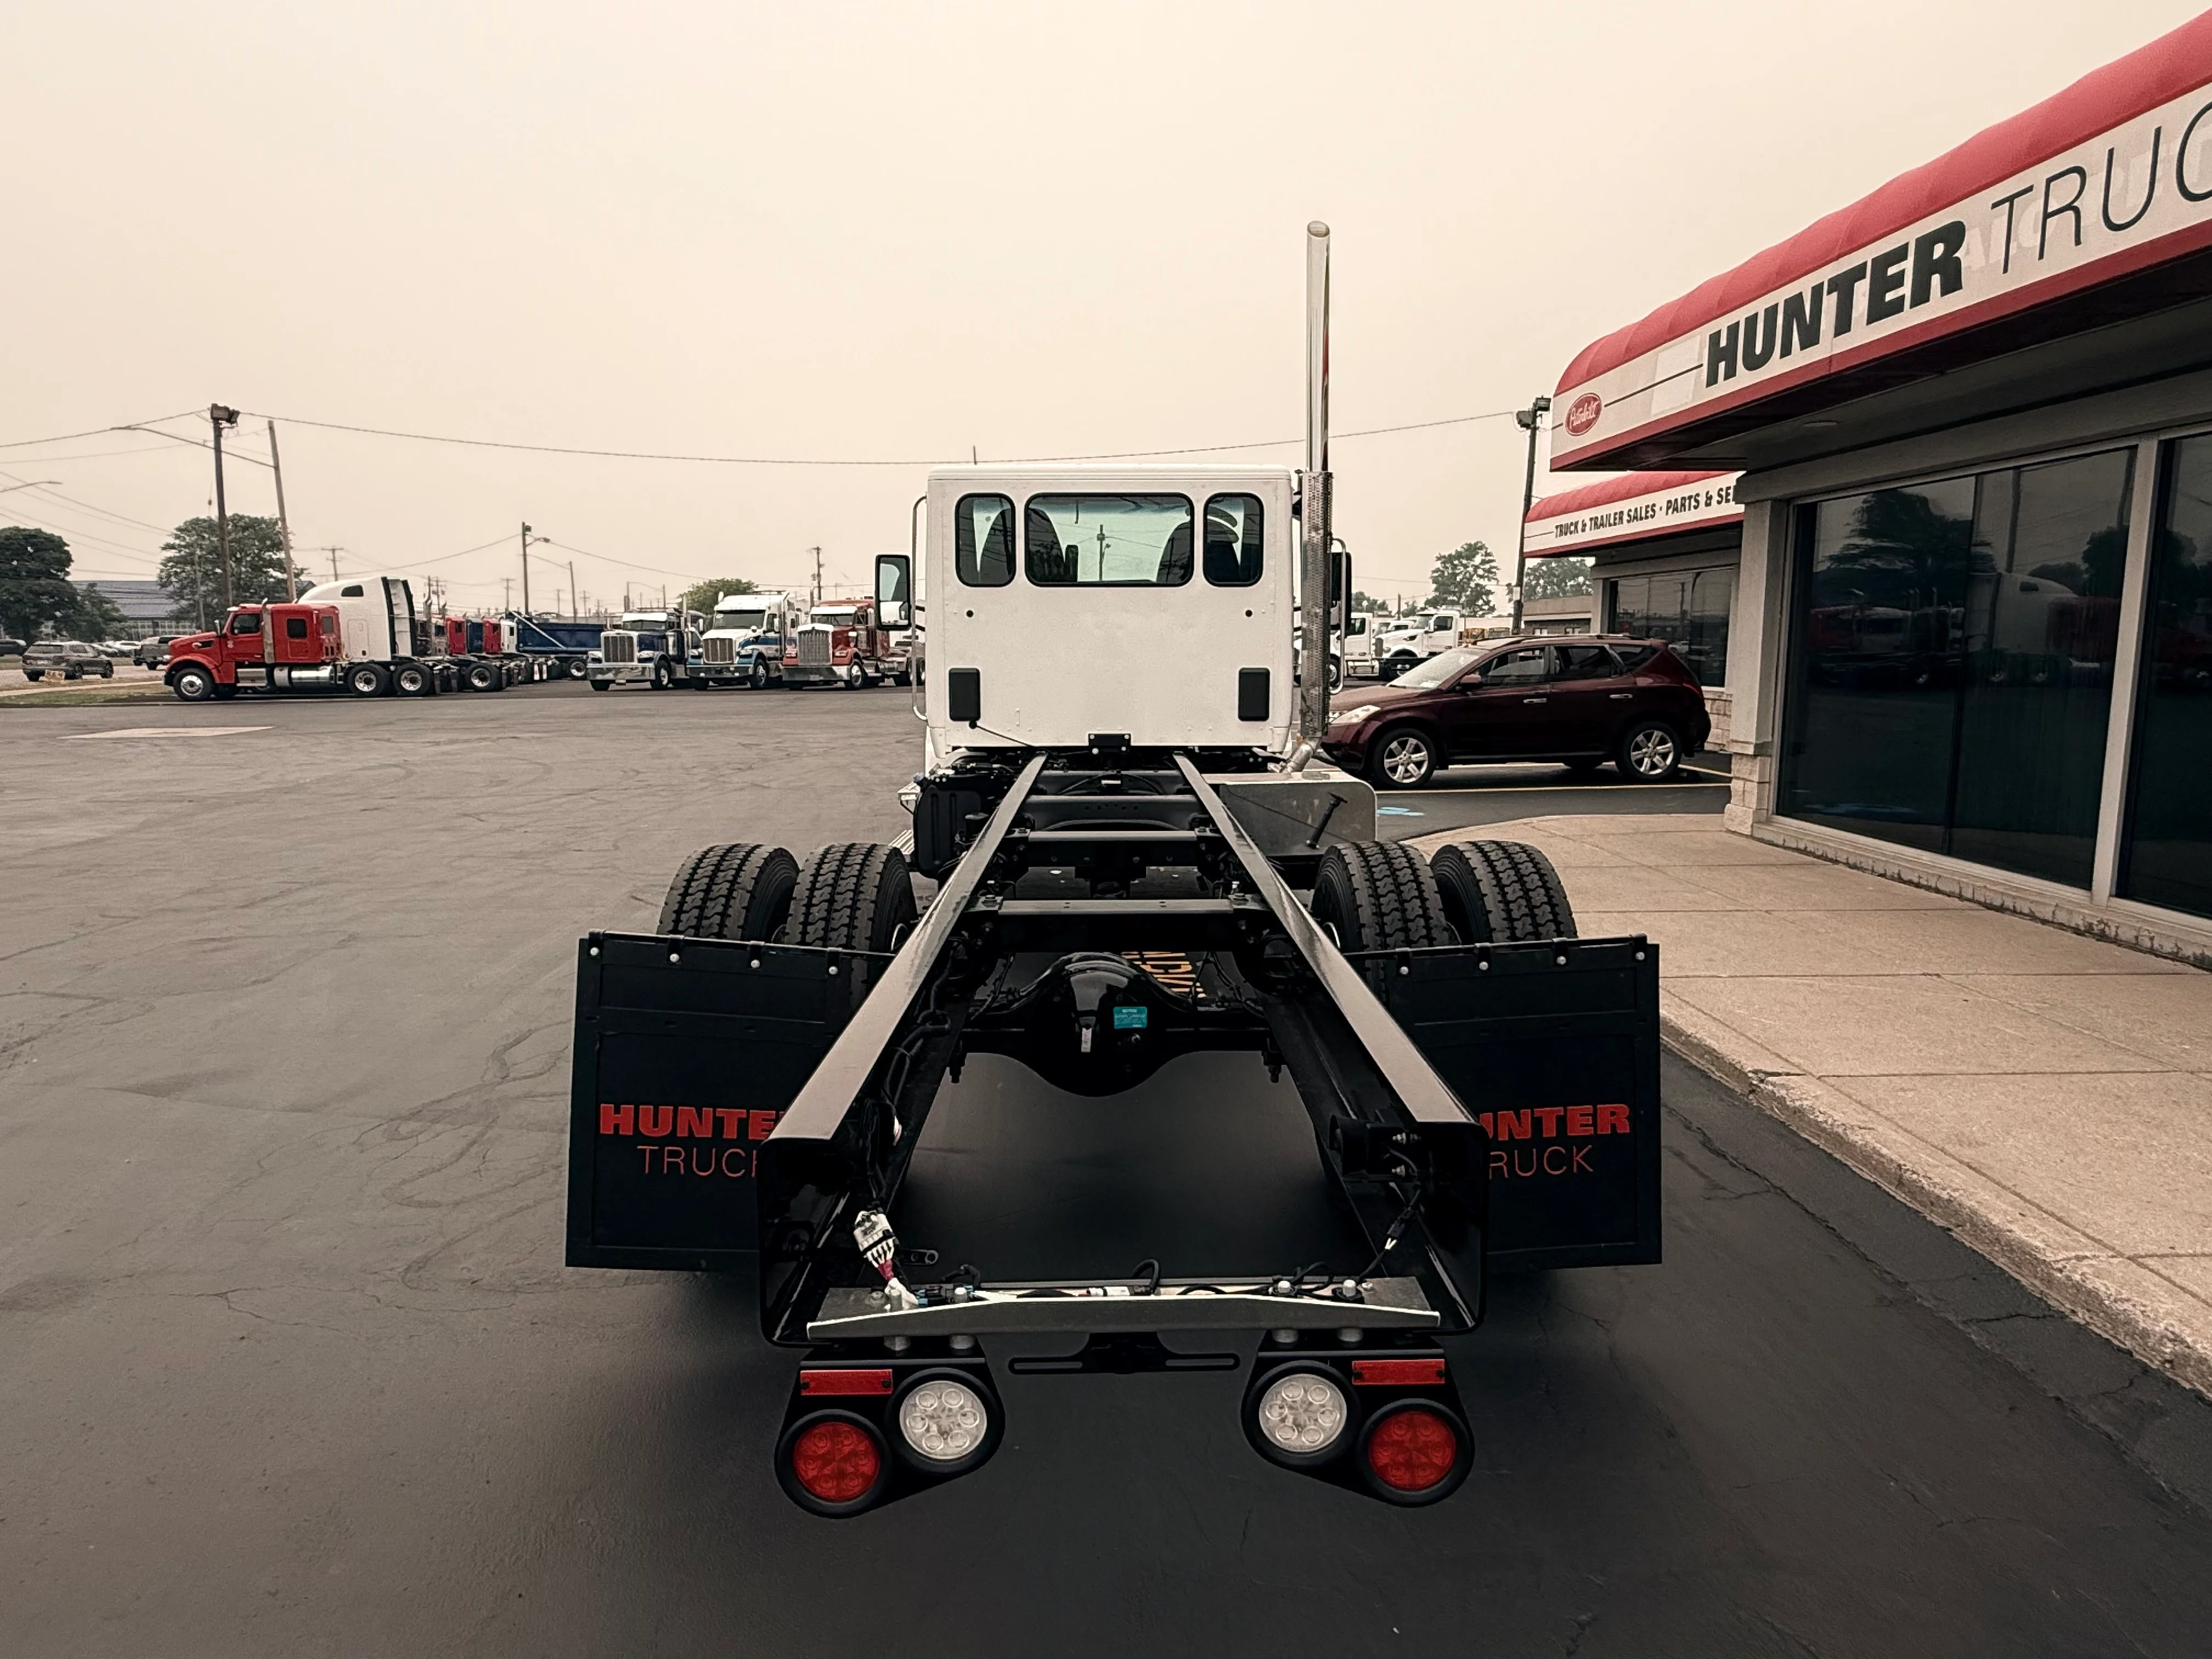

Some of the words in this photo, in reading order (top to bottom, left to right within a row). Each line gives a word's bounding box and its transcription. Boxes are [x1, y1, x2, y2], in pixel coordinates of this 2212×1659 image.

[1706, 221, 1966, 388] HUNTER
[1555, 521, 1579, 538] TRUCK
[1581, 519, 1587, 533] &
[1589, 511, 1624, 531] TRAILER
[1627, 503, 1656, 524] SALES
[1666, 493, 1700, 516] PARTS
[1704, 490, 1713, 507] &
[1717, 486, 1734, 505] SE
[600, 1103, 786, 1140] HUNTE
[637, 1146, 757, 1178] TRUC
